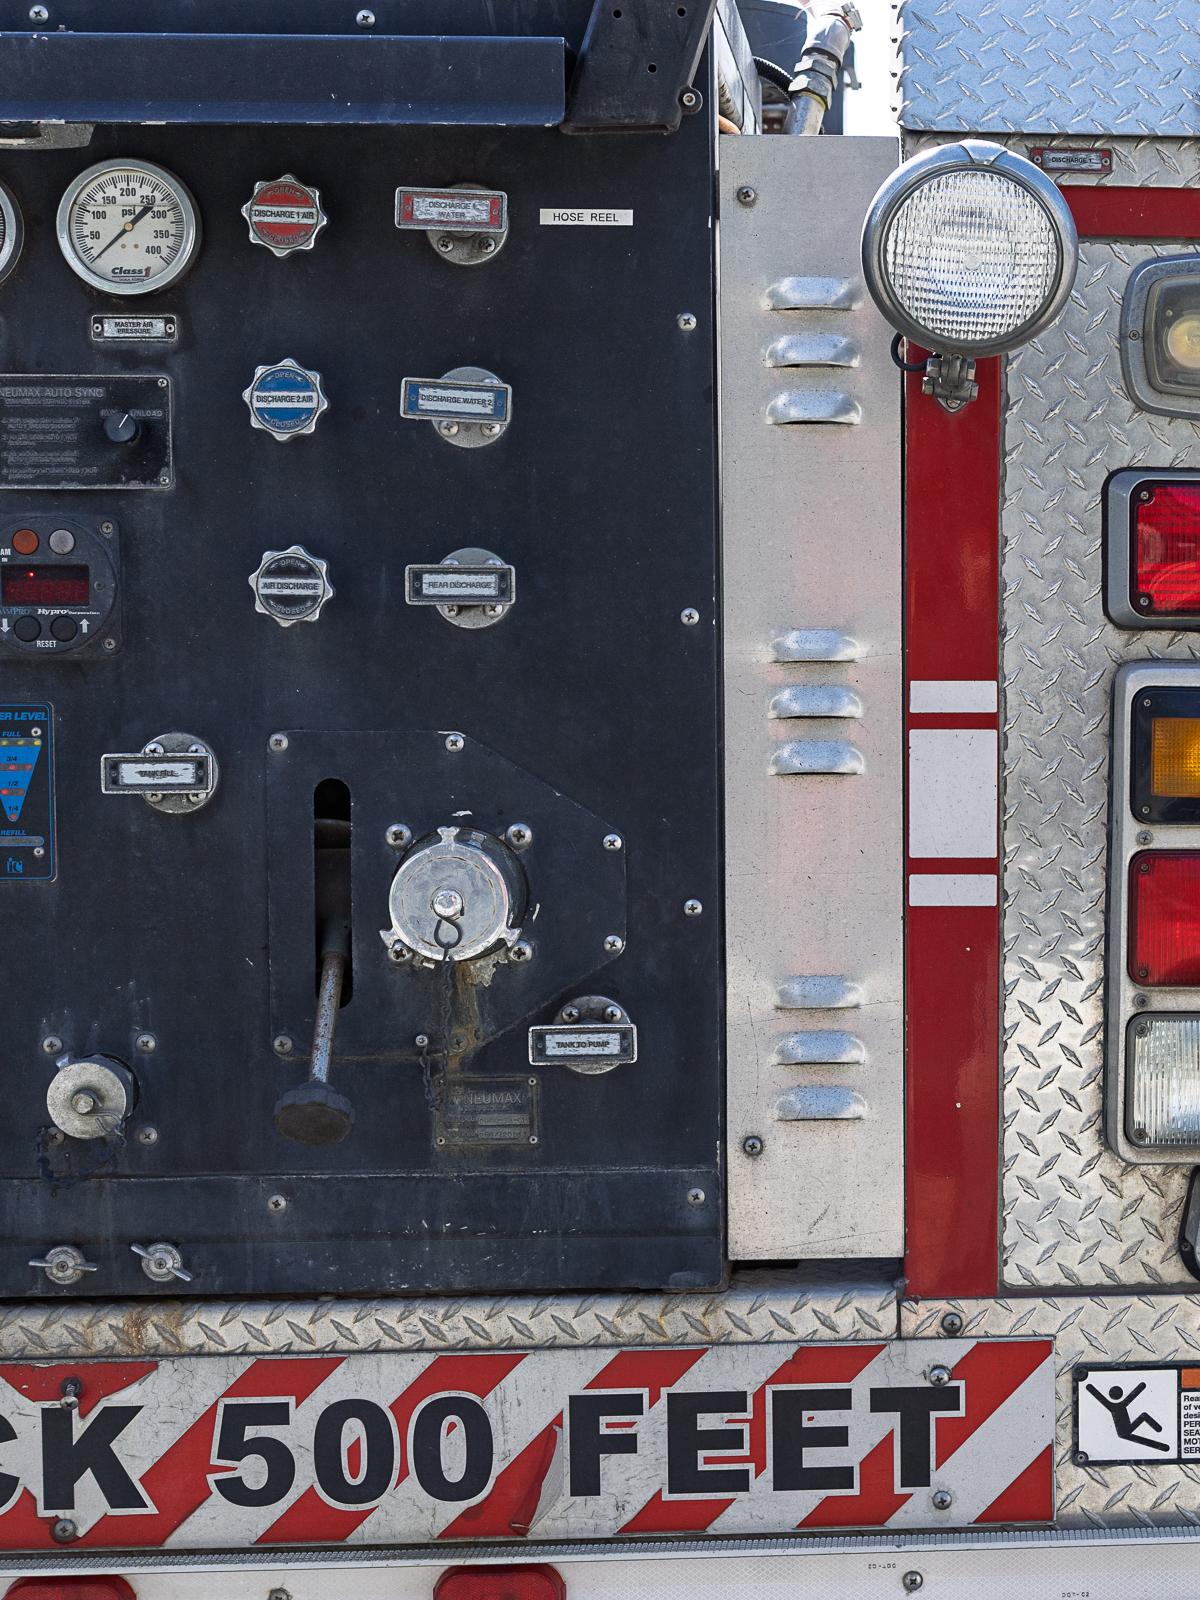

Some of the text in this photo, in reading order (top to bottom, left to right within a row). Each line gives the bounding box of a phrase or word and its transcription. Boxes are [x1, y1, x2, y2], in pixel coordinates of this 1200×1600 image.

[119, 187, 136, 197] 200
[101, 196, 117, 205] 150
[140, 195, 156, 205] 250
[429, 201, 471, 210] DISCHARGE
[91, 211, 107, 220] 100
[121, 205, 136, 218] psi
[151, 210, 167, 219] 300
[254, 209, 295, 219] DISCHARGE
[301, 211, 314, 220] AIR
[438, 211, 466, 219] WATER
[553, 212, 620, 222] HOSE REEL
[89, 231, 101, 240] 50
[153, 230, 170, 239] 350
[145, 246, 162, 255] 400
[44, 387, 72, 398] AUTO
[74, 387, 104, 398] SYNC
[256, 394, 295, 404] DISCHARGE
[301, 394, 314, 404] AIR
[420, 394, 462, 404] DISCHARGE
[462, 397, 486, 406] WATER
[129, 408, 163, 417] UNLOAD
[279, 558, 301, 566] OPEN
[262, 581, 319, 591] AIR DISCHARGE
[428, 581, 492, 589] REAR DISCHARGE
[36, 640, 57, 648] RESET
[14, 711, 48, 721] LEVEL
[556, 1040, 610, 1049] TANK TO PUMP
[0, 1386, 961, 1511] K 500 FEET
